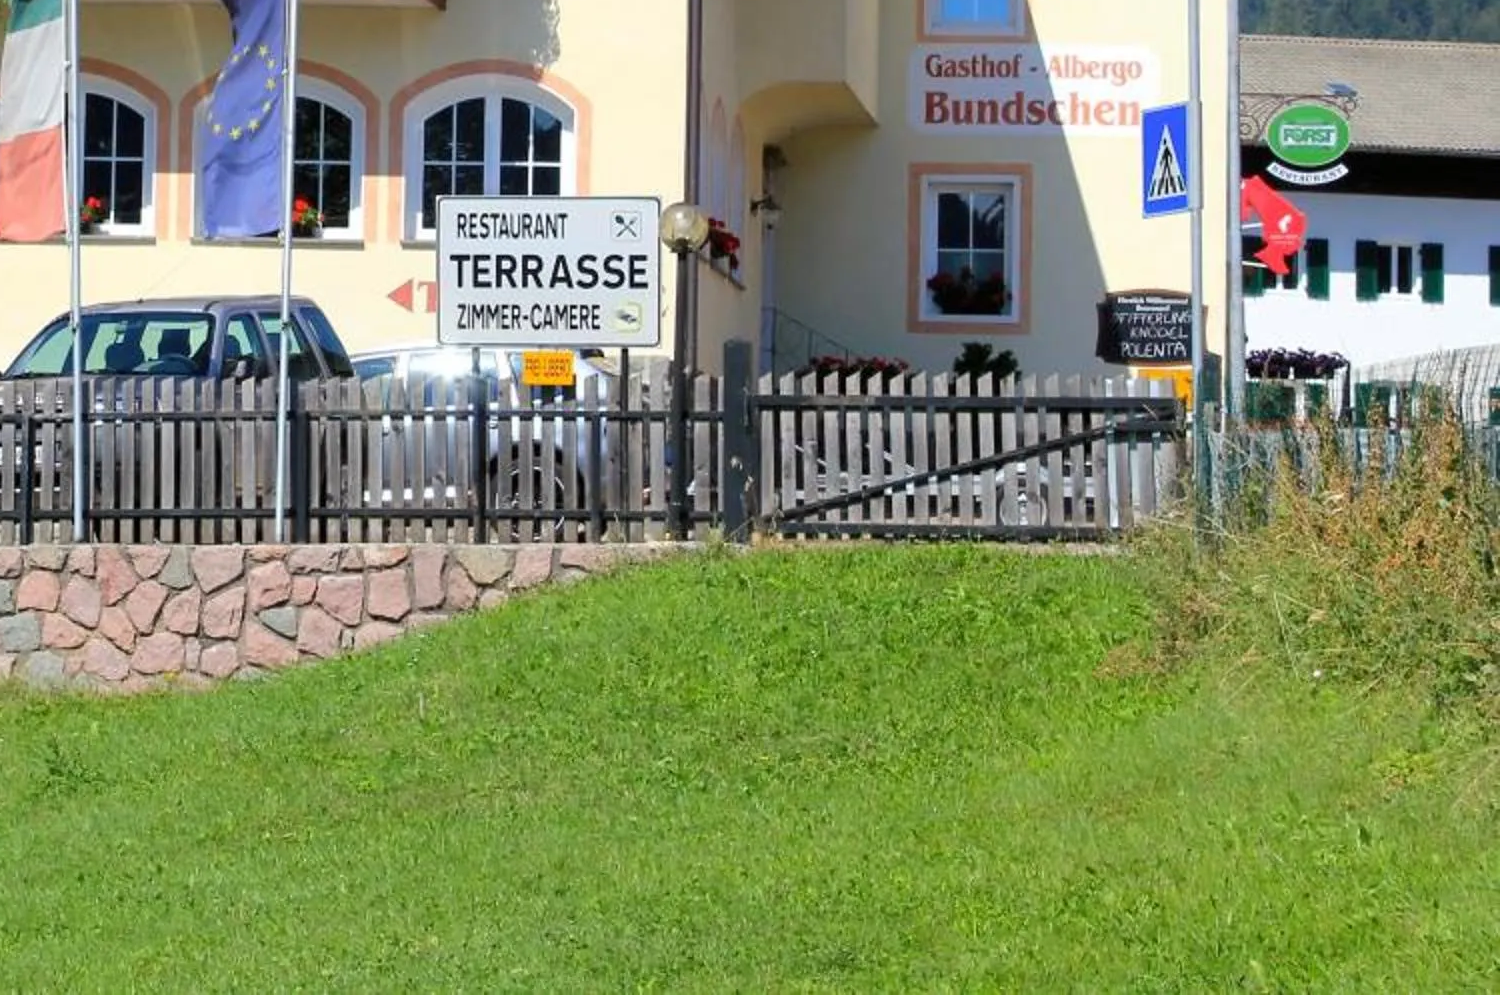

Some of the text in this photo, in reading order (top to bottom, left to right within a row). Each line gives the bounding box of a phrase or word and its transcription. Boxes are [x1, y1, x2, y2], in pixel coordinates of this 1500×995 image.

[924, 53, 1023, 78] Gasthof
[1046, 54, 1143, 86] Albergo
[923, 91, 1141, 126] Bundschen
[456, 212, 568, 239] RESTAURANT
[449, 254, 649, 290] TERRASSE
[456, 303, 601, 330] ZIMMER-CAMERE
